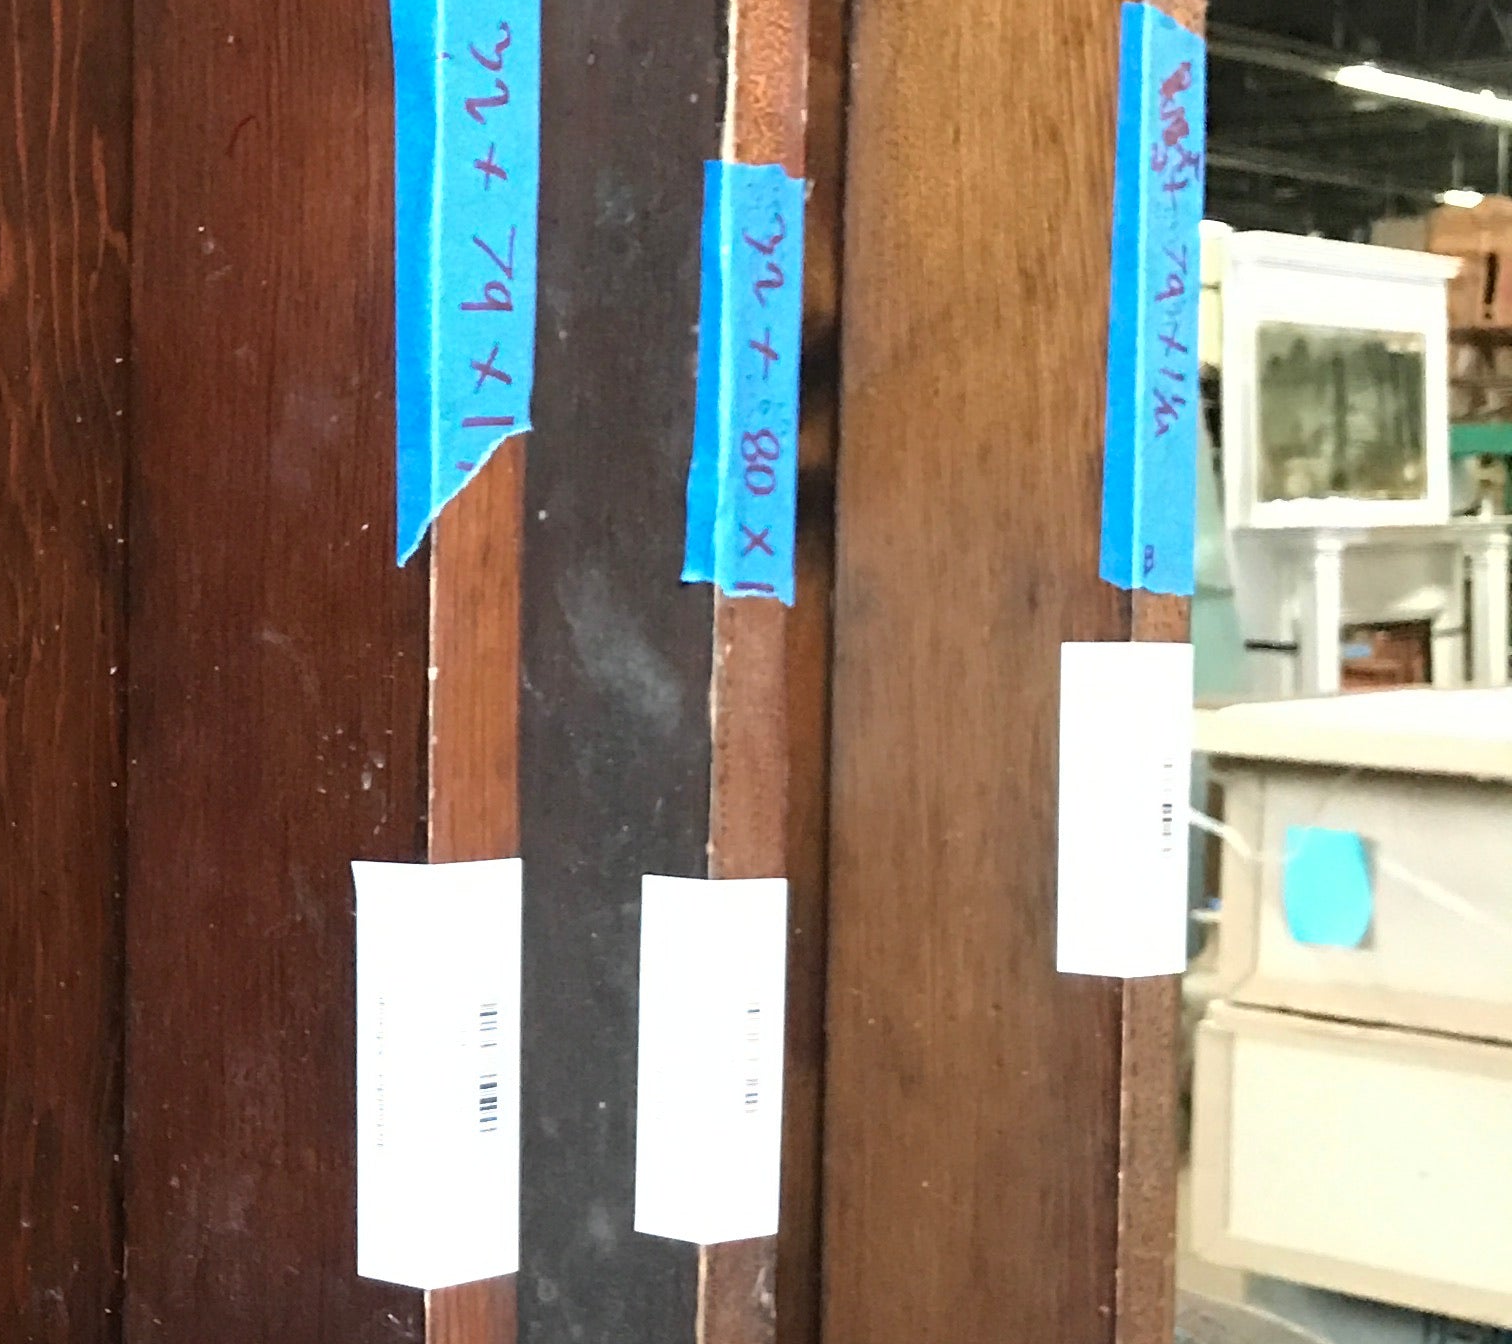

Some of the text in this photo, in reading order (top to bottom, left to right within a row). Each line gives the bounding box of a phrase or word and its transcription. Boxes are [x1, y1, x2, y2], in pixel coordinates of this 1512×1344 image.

[464, 20, 512, 125] 32
[458, 226, 518, 313] 79
[739, 427, 781, 497] 80
